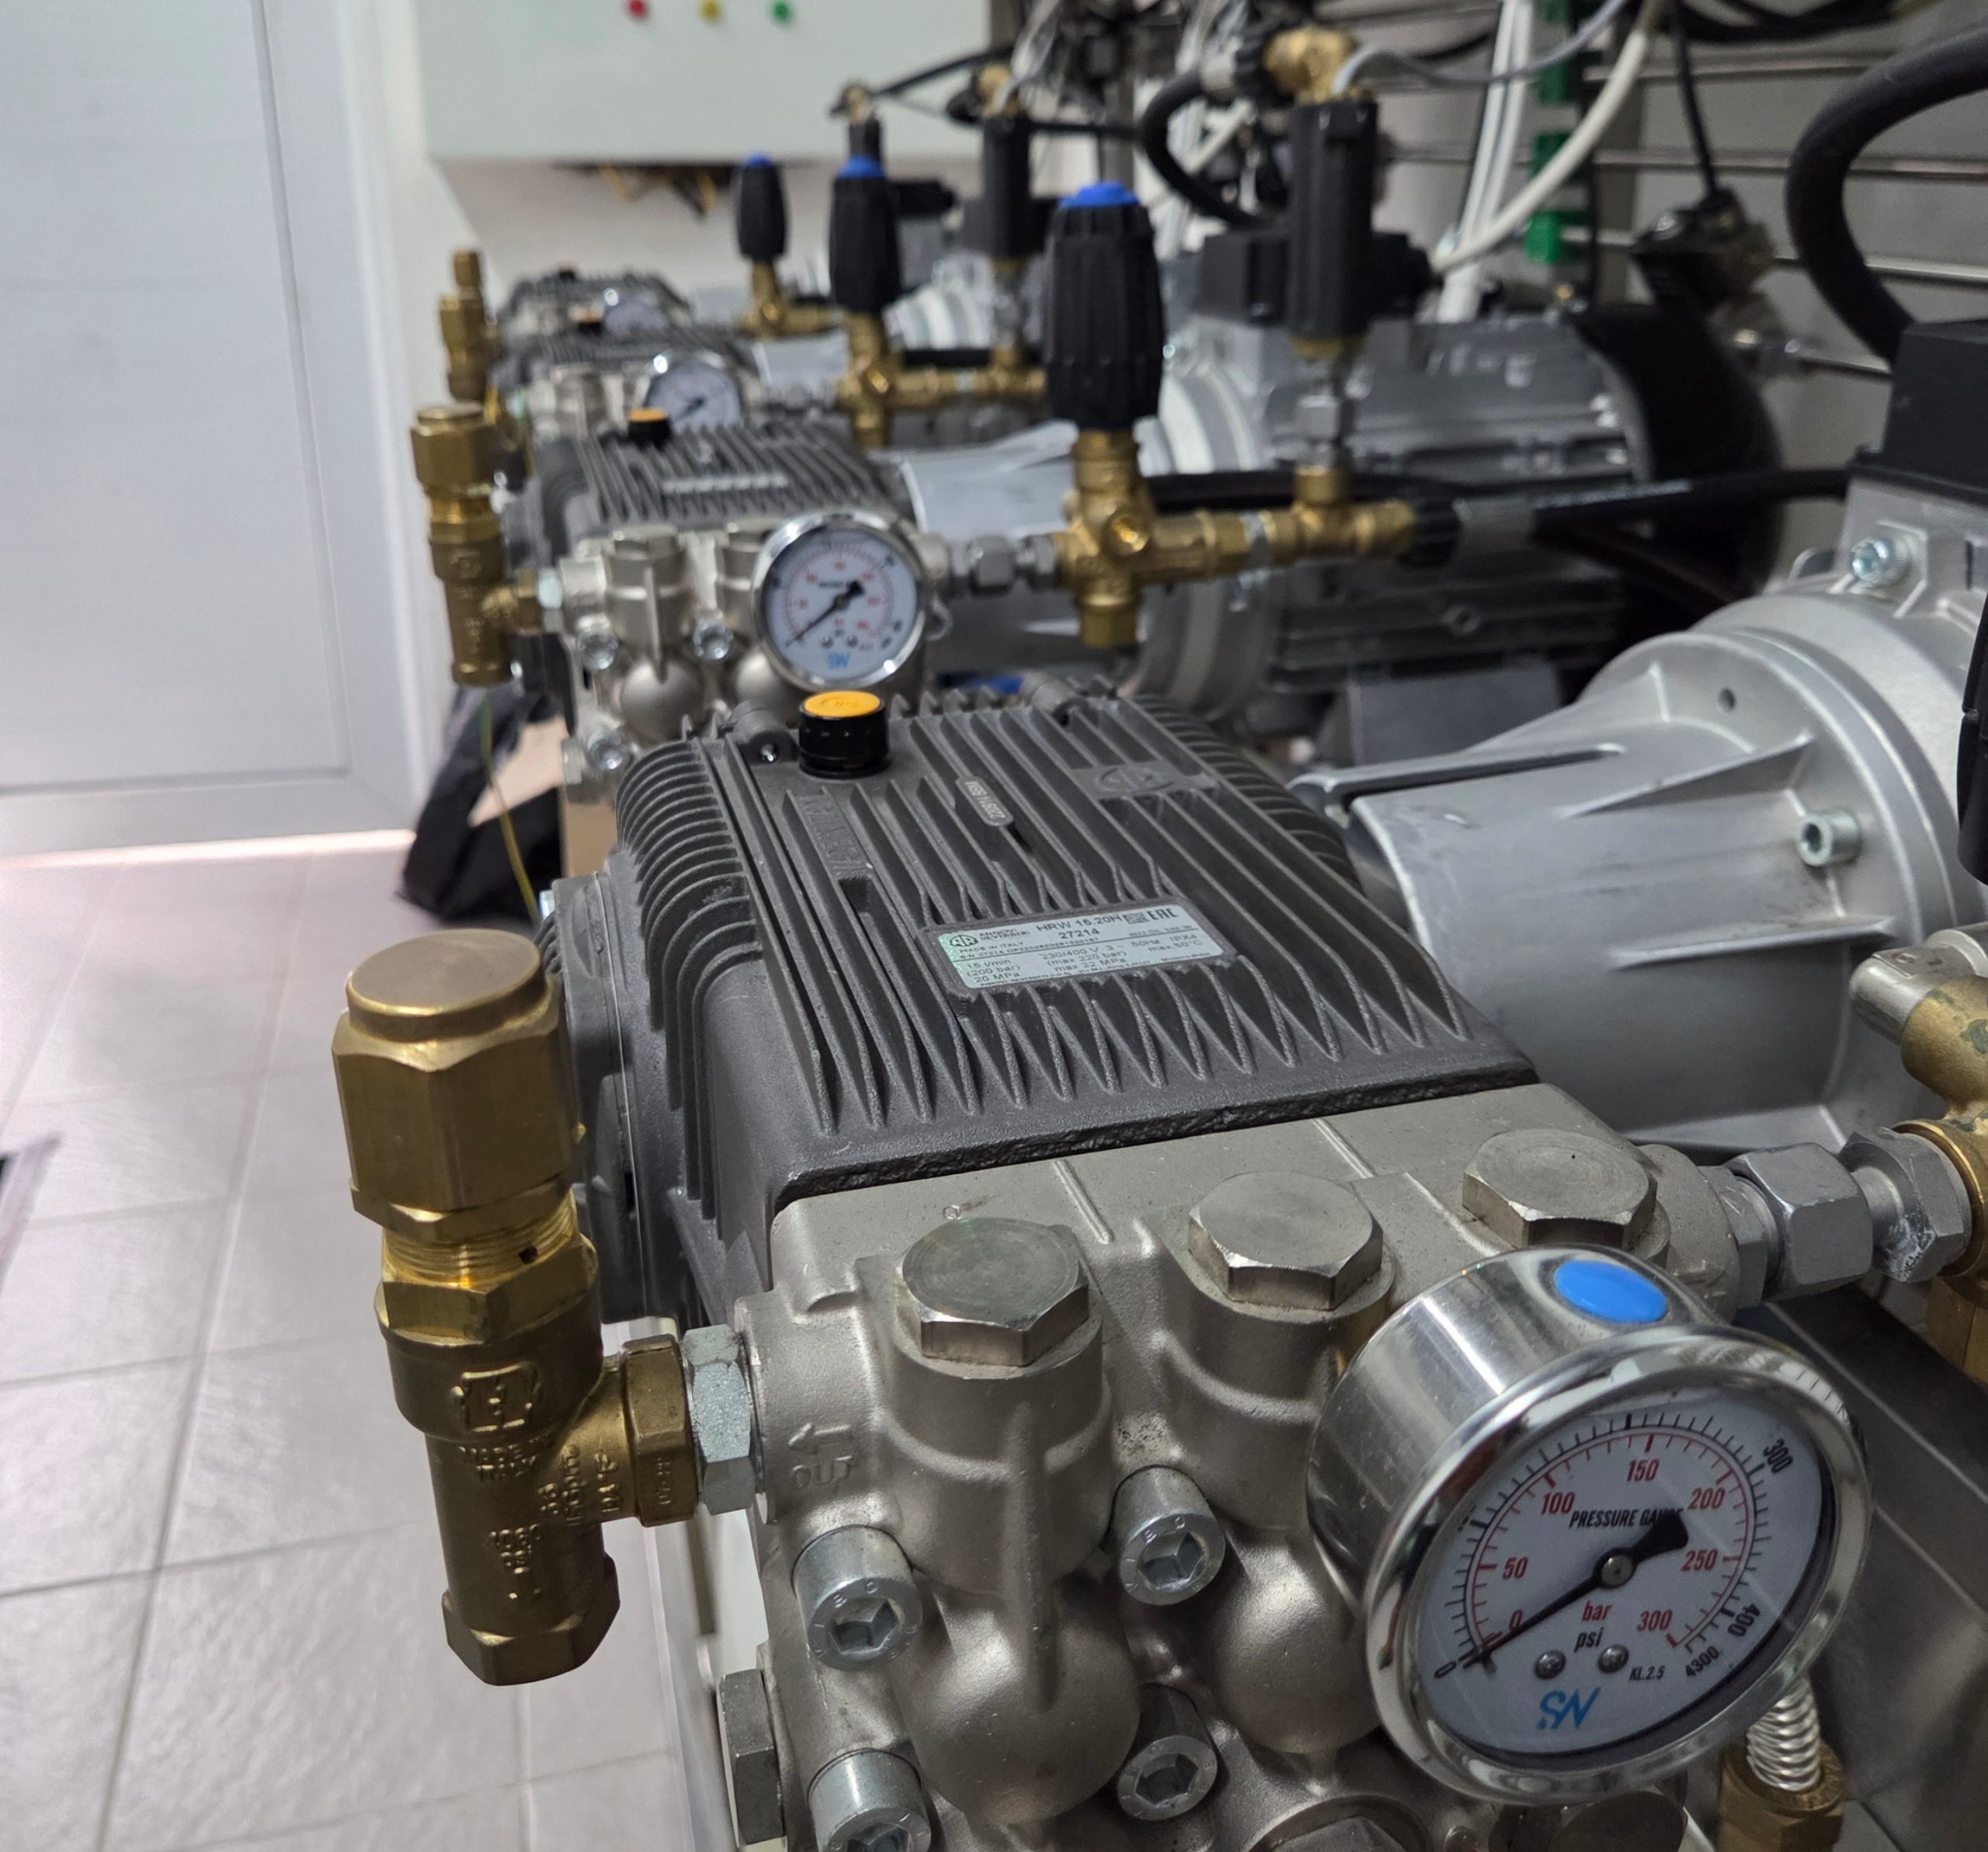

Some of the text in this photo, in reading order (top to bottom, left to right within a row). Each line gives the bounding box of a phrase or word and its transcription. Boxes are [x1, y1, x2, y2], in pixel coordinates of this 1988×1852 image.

[1036, 922, 1072, 932] HRW
[1058, 928, 1100, 940] 27214
[1039, 948, 1087, 960] 230/400
[1100, 957, 1127, 966] MPa
[967, 964, 1021, 977] (200 bar)
[993, 972, 1020, 981] MPa
[1763, 1438, 1794, 1474] 300
[1626, 1458, 1660, 1482] 150
[1541, 1492, 1576, 1515] 100
[1687, 1487, 1726, 1510] 200
[1569, 1509, 1639, 1529] PRESSURE
[1503, 1556, 1528, 1579] 50
[1680, 1548, 1718, 1572] 250
[1509, 1609, 1523, 1632] 0
[1582, 1600, 1613, 1621] bar
[1637, 1608, 1673, 1631] 300
[1727, 1603, 1760, 1637] 400
[1574, 1626, 1604, 1652] psi
[1685, 1645, 1719, 1677] 4300
